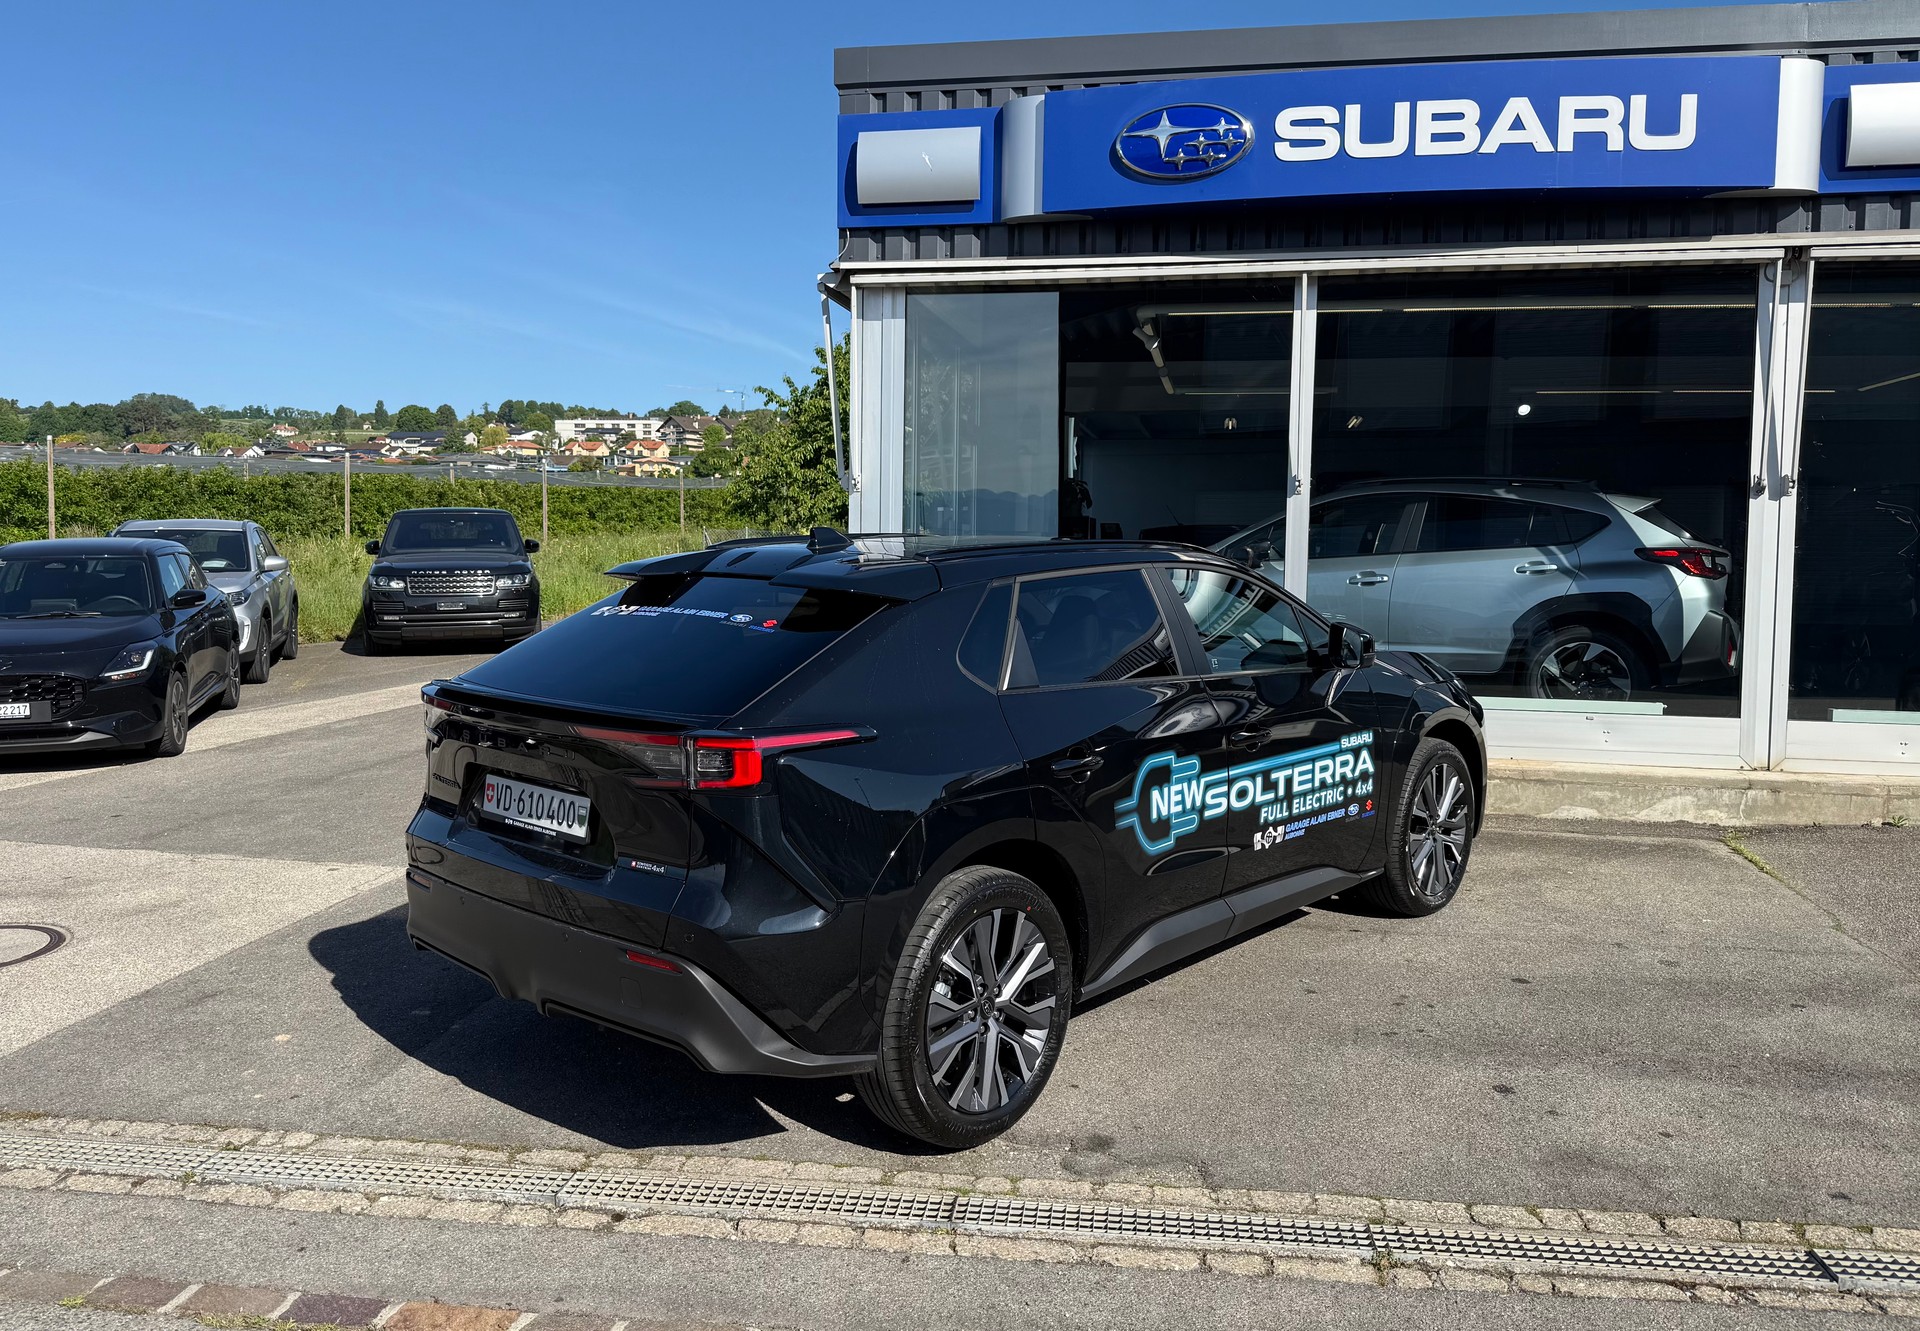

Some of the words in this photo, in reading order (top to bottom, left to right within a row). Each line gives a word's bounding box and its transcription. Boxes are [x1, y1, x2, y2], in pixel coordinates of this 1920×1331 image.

[1273, 93, 1698, 161] SUBARU
[1341, 731, 1373, 749] SUBARU
[1151, 780, 1206, 819] NEW
[1203, 750, 1375, 818] SOLTERRA
[1260, 804, 1289, 824] FULL
[1292, 787, 1344, 815] ELECTRIC
[1355, 778, 1374, 796] 4x4
[1286, 818, 1311, 833] GARAGE
[1310, 813, 1328, 826] ALAIN
